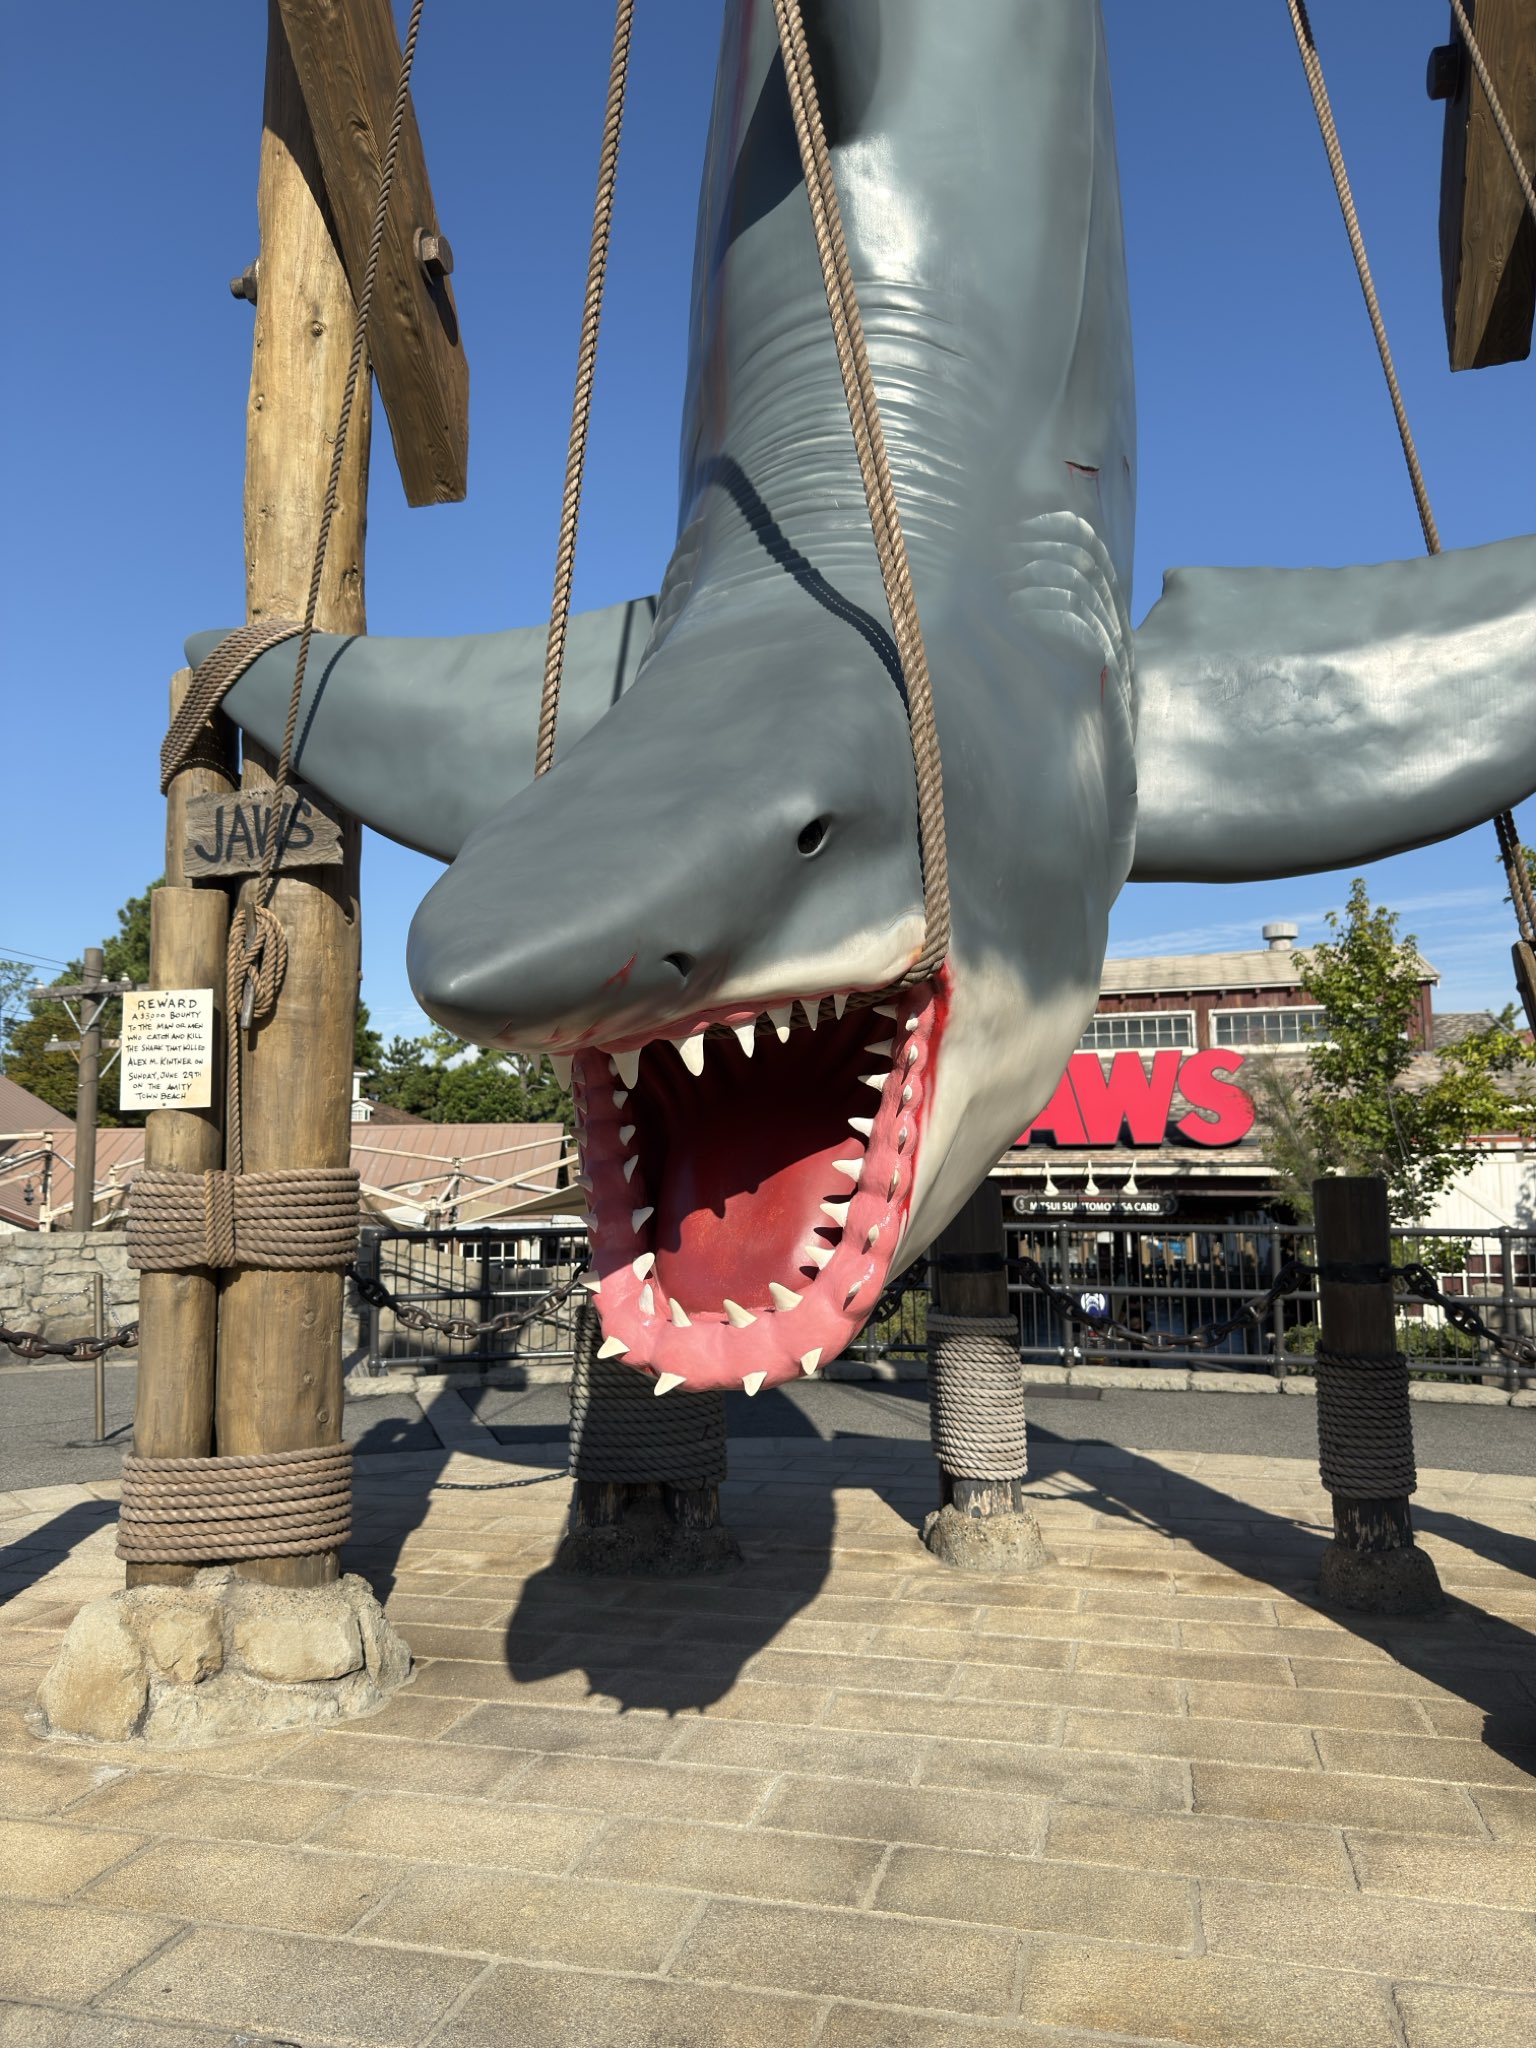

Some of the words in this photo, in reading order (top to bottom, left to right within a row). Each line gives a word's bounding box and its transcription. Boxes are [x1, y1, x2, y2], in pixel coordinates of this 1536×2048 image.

[194, 799, 314, 863] JAWS
[137, 998, 198, 1010] REWARD
[170, 1011, 202, 1019] BOUNTY
[138, 1023, 152, 1031] THE
[187, 1032, 203, 1040] KILL
[125, 1044, 138, 1052] THE
[141, 1044, 163, 1052] SHARK
[127, 1056, 147, 1066] ALEX
[160, 1057, 192, 1065] KINTNER
[159, 1071, 178, 1079] JUNE
[135, 1092, 159, 1100] TOWN
[160, 1092, 187, 1100] BEACH
[1014, 1048, 1256, 1146] AWS
[1134, 1202, 1160, 1212] CARD
